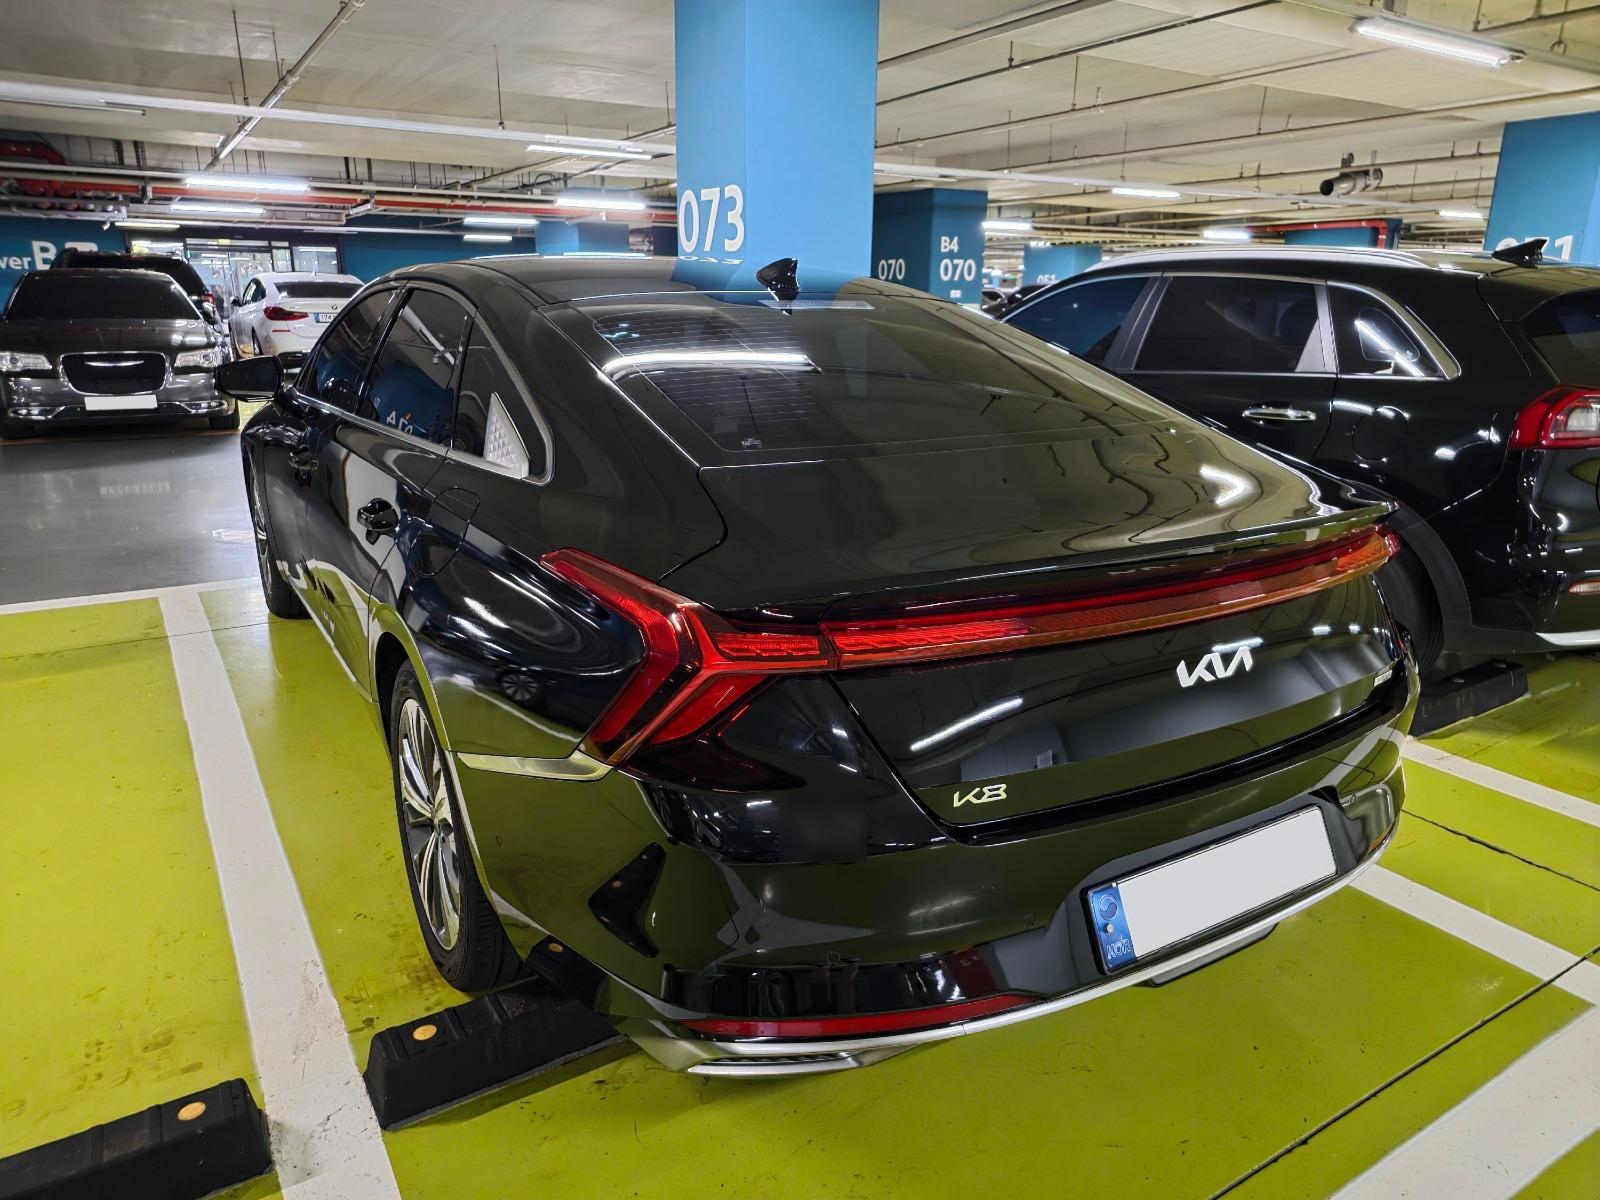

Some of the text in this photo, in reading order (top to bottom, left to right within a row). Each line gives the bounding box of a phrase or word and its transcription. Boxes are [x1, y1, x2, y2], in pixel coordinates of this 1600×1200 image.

[679, 184, 745, 254] 073
[940, 236, 959, 254] B4
[878, 258, 906, 281] 070
[939, 258, 977, 281] 070
[1176, 645, 1254, 688] KIA
[953, 783, 1008, 808] K8
